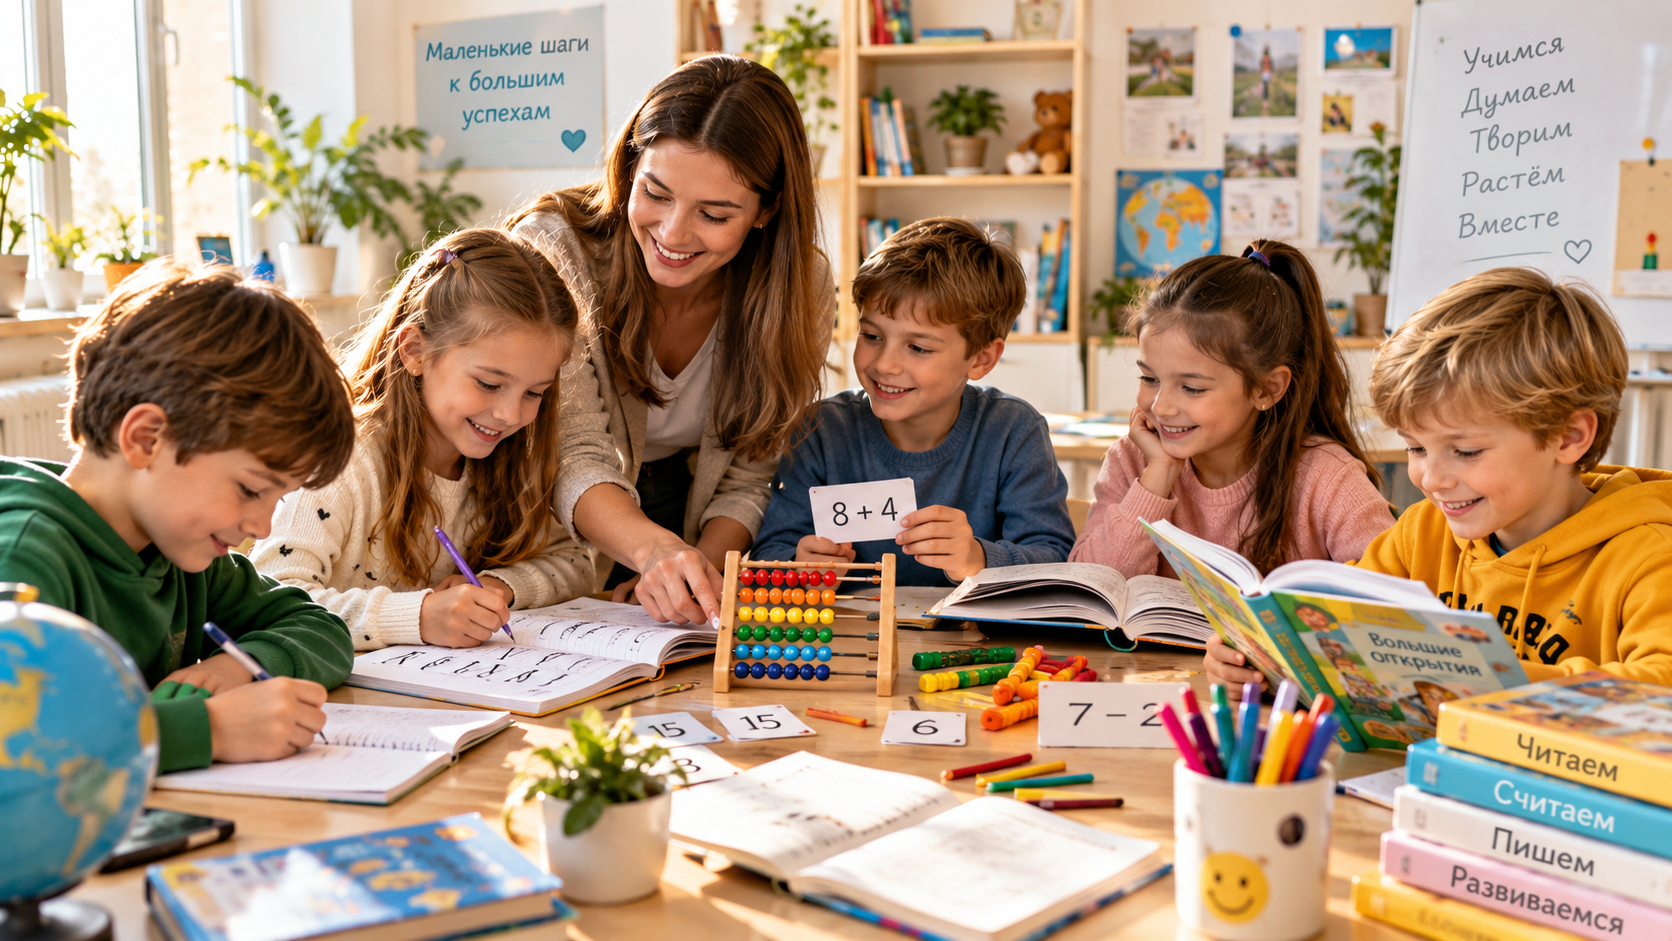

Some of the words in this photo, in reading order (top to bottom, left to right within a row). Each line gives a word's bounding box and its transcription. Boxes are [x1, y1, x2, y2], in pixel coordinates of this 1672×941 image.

[425, 41, 533, 62] Маленькие
[540, 38, 590, 54] шаги
[1463, 37, 1565, 75] Учимся
[449, 78, 461, 93] к
[469, 69, 565, 92] большим
[1460, 78, 1576, 119] Думаем
[461, 105, 551, 131] успехам
[1469, 122, 1573, 157] Творим
[1462, 165, 1566, 197] Растём
[1458, 211, 1560, 239] Вместе
[832, 502, 849, 527] 8
[881, 497, 898, 521] 4
[648, 722, 686, 738] 15
[740, 713, 782, 731] 15
[912, 719, 939, 736] 6
[1069, 703, 1094, 726] 7
[1140, 703, 1164, 727] 2
[1517, 733, 1618, 782] Читаем
[1494, 780, 1615, 833] Считаем
[1491, 827, 1595, 877] Пишем
[1450, 865, 1624, 935] Развиваемся
